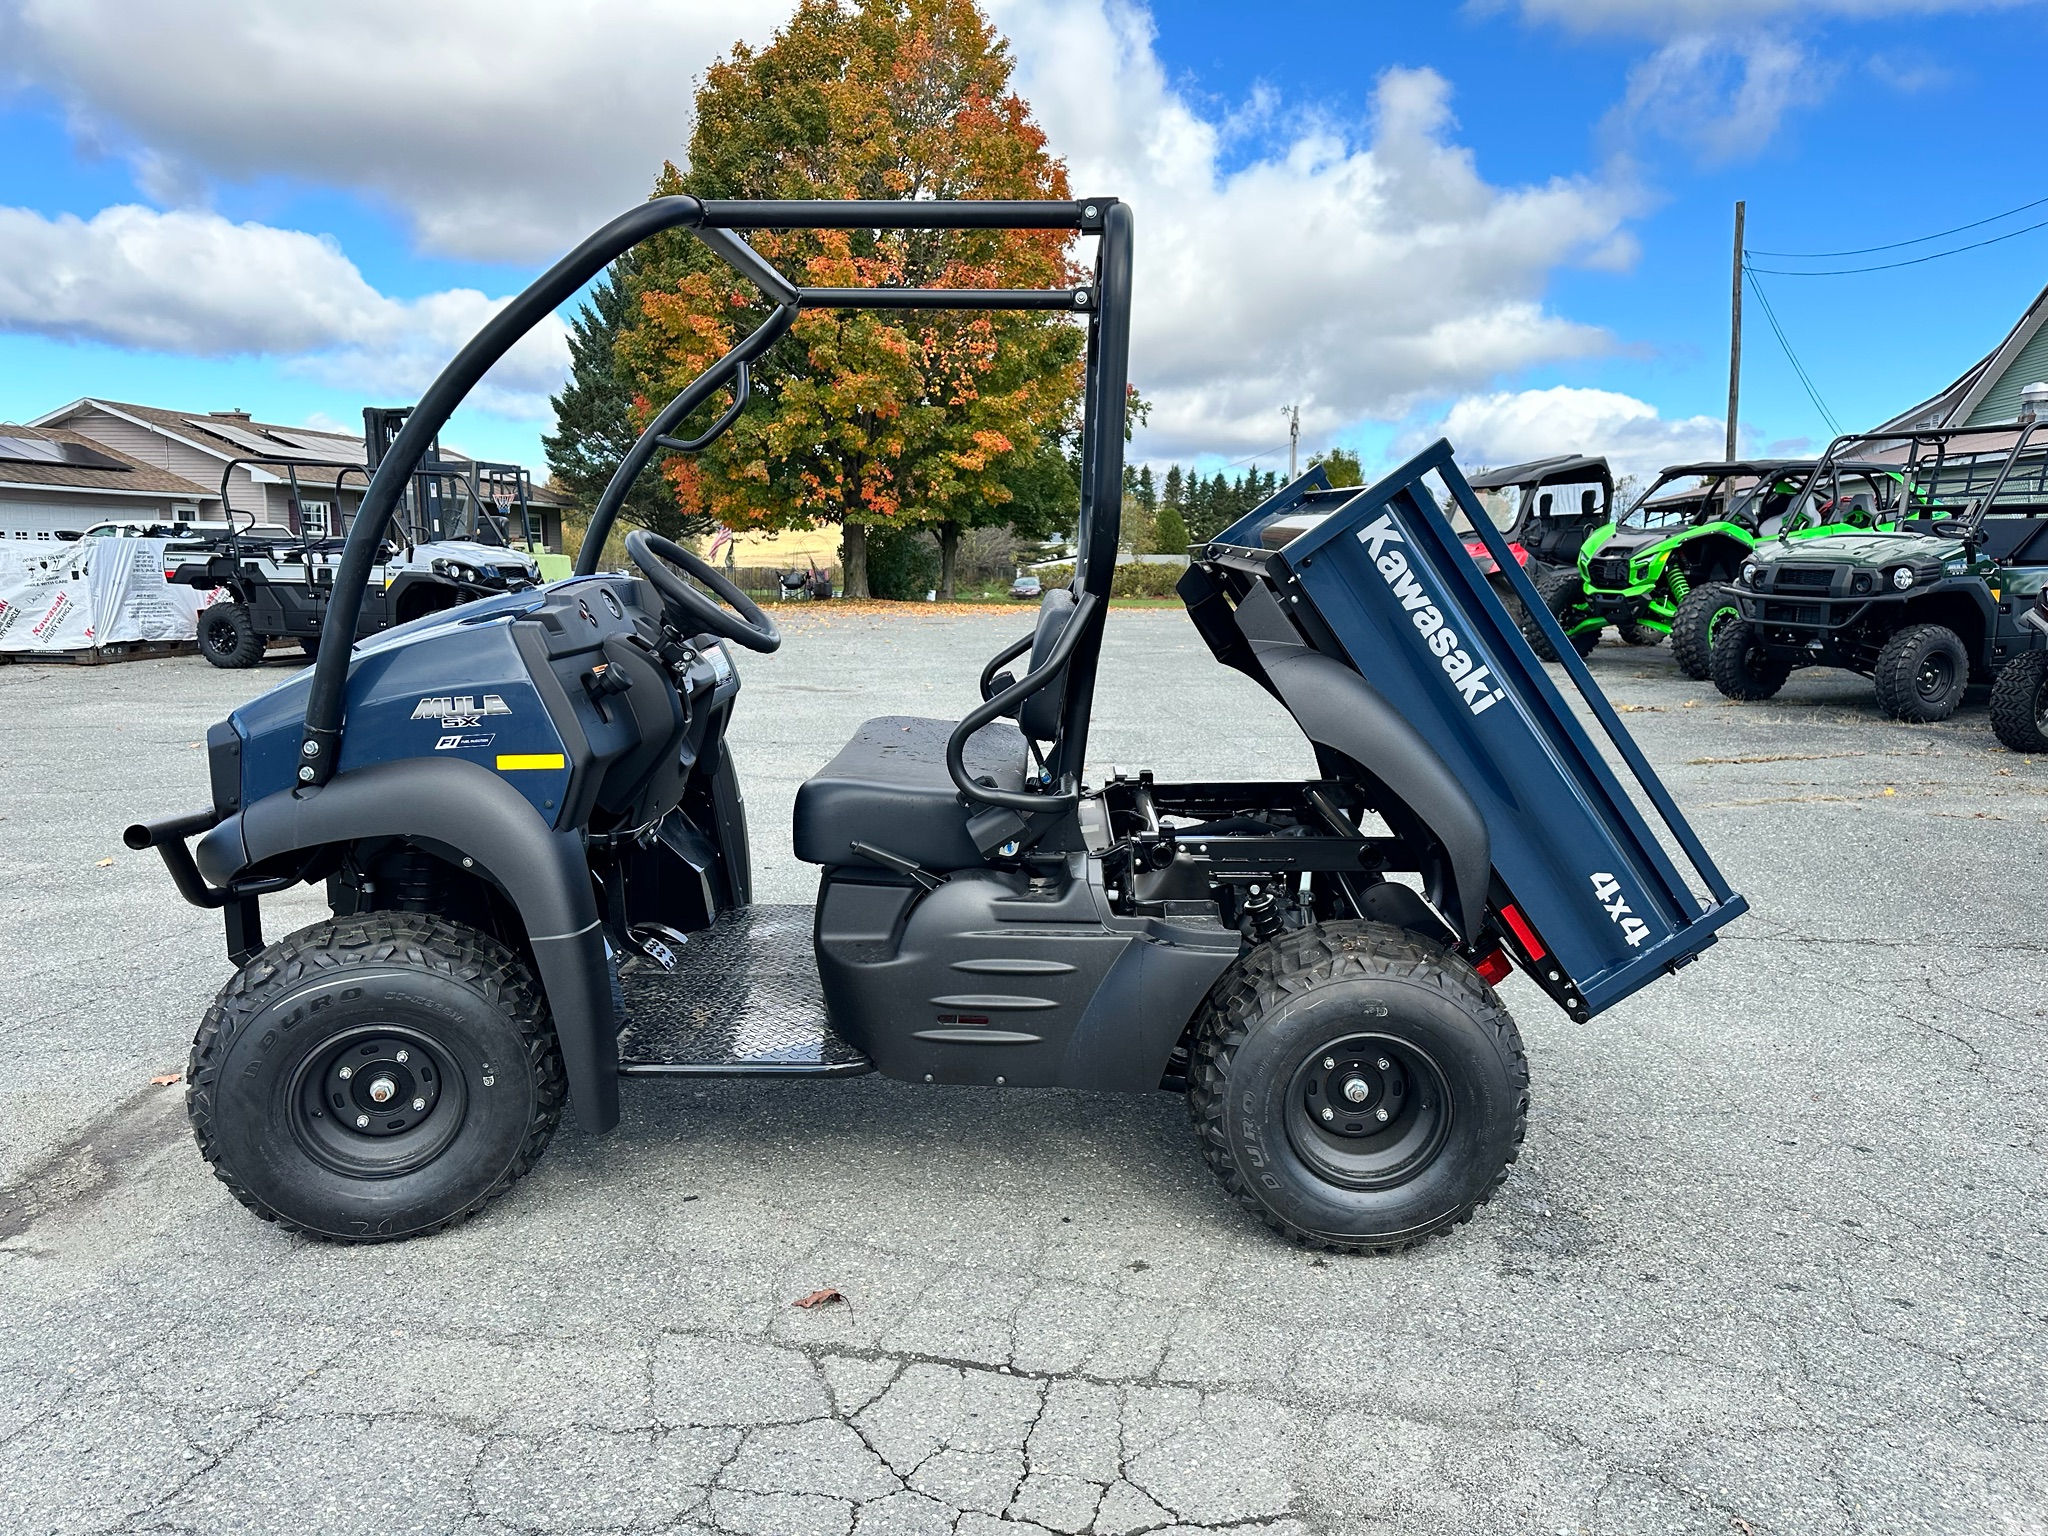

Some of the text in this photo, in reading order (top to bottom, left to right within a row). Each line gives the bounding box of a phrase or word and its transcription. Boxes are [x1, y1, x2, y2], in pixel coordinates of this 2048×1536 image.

[5, 607, 21, 628] VEHICLE
[32, 591, 67, 636] Kawasaki
[43, 624, 59, 644] UTILITY
[56, 602, 75, 624] VEHICLE
[1357, 514, 1505, 715] Kawasaki
[410, 694, 513, 720] MULE
[442, 716, 482, 728] SX
[439, 738, 457, 747] FI
[1589, 872, 1651, 947] 4x4
[259, 988, 363, 1055] DURO
[1241, 1090, 1285, 1190] DURO
